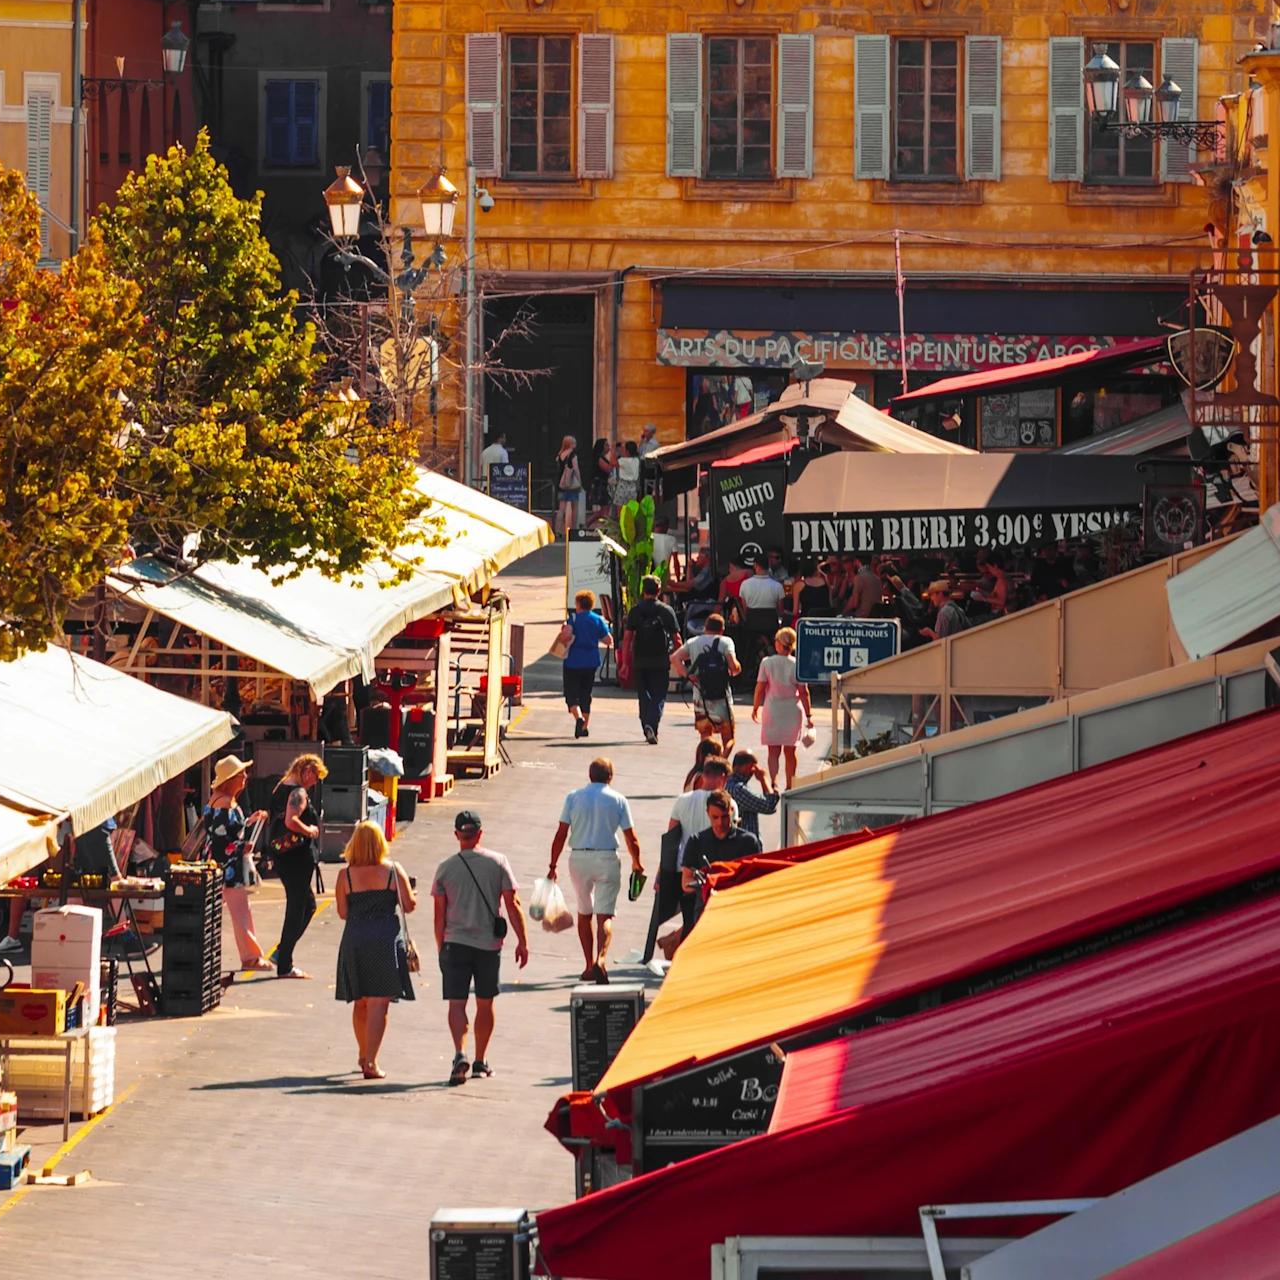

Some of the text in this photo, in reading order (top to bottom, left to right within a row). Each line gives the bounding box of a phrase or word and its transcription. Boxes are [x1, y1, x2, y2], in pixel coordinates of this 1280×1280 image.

[661, 337, 718, 358] ARTS
[724, 338, 756, 359] DU
[764, 338, 887, 362] PACIFIQUE
[910, 341, 1028, 364] PEINTURES
[720, 475, 743, 491] MAXI
[722, 481, 775, 514] MOJITO
[739, 511, 766, 532] 6 €
[791, 518, 875, 553] PINTE
[881, 515, 966, 551] BIERE
[974, 513, 1043, 550] 3,90€
[804, 627, 889, 639] TOILETTES PUBLIQUES
[831, 637, 861, 646] SALEYA
[673, 1128, 709, 1136] understand
